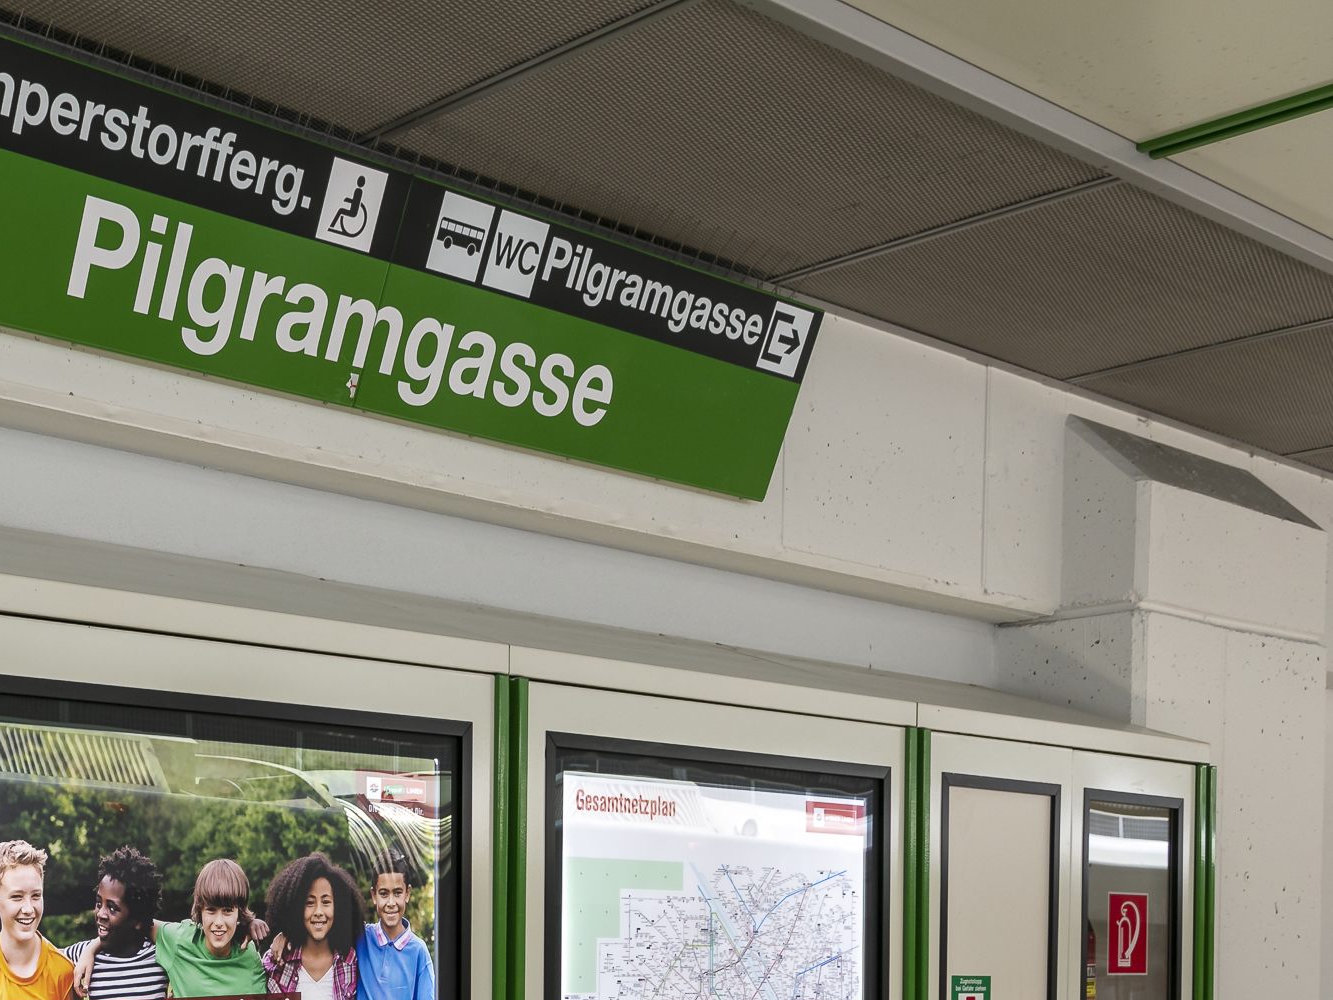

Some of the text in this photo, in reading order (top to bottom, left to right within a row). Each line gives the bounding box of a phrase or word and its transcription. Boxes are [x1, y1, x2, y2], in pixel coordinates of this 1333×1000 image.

[66, 194, 614, 427] Pilgramgasse
[495, 231, 763, 345] WC Pilgramgasse
[575, 789, 676, 820] Gesamtnetzplan
